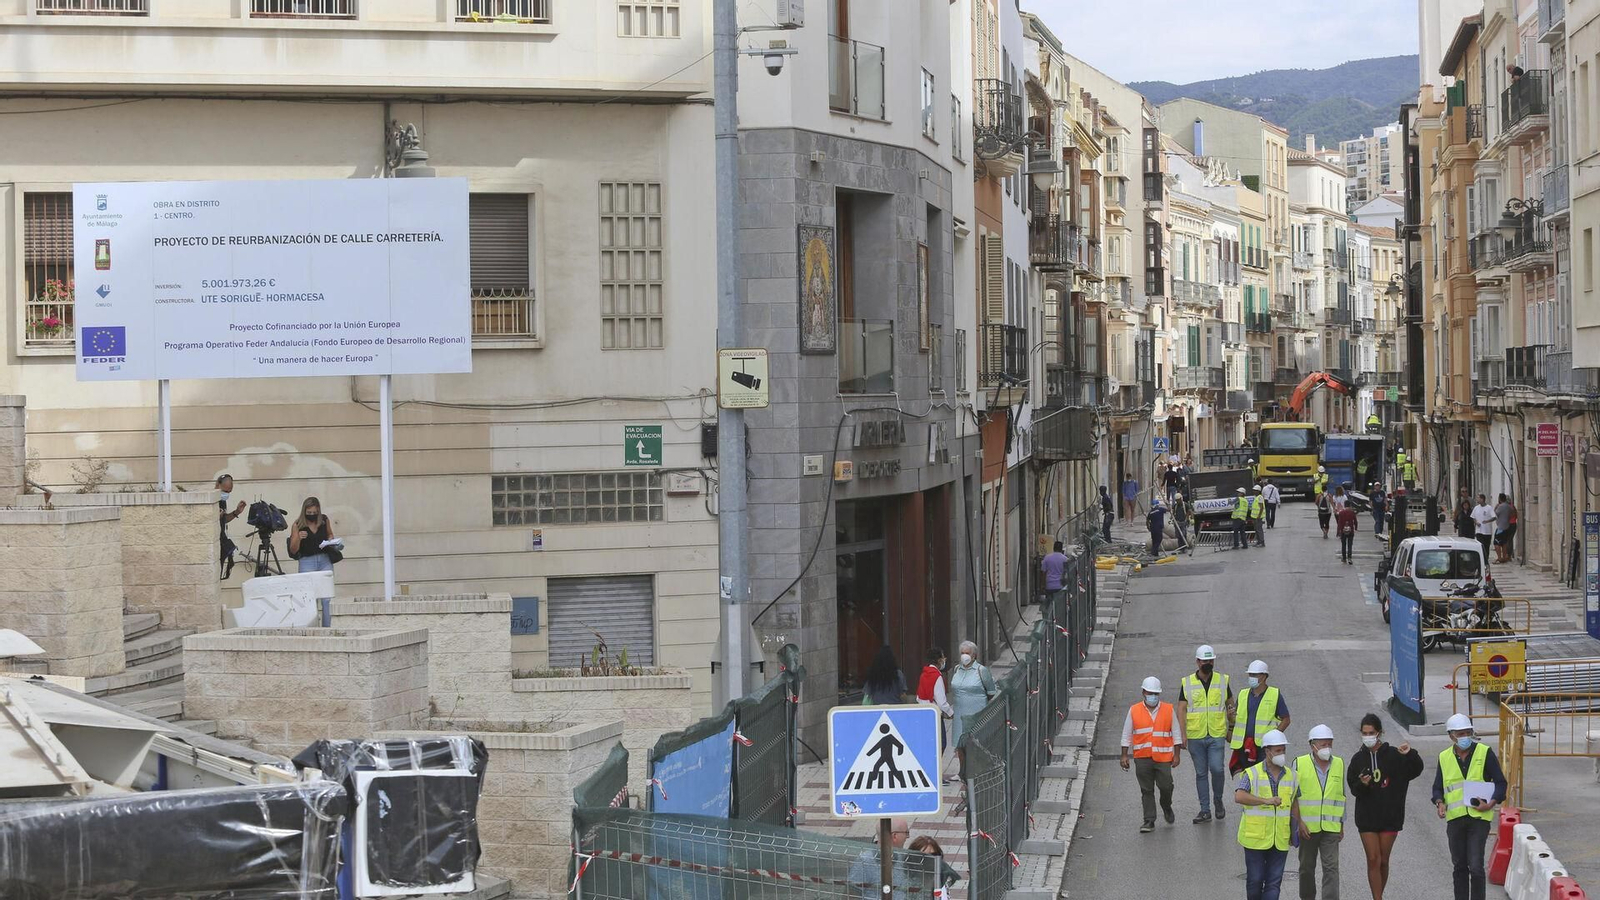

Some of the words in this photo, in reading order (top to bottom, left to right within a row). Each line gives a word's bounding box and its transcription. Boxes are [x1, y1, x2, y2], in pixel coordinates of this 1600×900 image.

[153, 201, 174, 209] OBRA
[175, 200, 185, 208] EN
[187, 200, 220, 208] DISTRITO
[81, 213, 123, 221] Ayuntamiento
[154, 212, 159, 220] 1
[86, 220, 95, 228] de
[96, 219, 118, 228] Málaga
[154, 236, 209, 247] PROYECTO
[211, 236, 226, 246] DE
[228, 233, 321, 245] REURBANIZACIÓN
[323, 234, 338, 244] DE
[340, 233, 374, 243] CALLE
[376, 231, 444, 243] CARRETERÍA.
[268, 278, 276, 288] €
[201, 294, 218, 304] UTE
[266, 292, 325, 302] HORMACESA
[229, 322, 264, 332] Proyecto
[265, 322, 318, 331] Cofinanciado
[319, 322, 332, 331] por
[334, 321, 342, 329] la
[343, 320, 366, 329] Unión
[368, 320, 401, 330] Europea
[164, 341, 204, 351] Programa
[205, 340, 244, 350] Operativo
[245, 339, 268, 348] Feder
[270, 338, 309, 348] Andalucía
[310, 338, 339, 347] (Fondo
[340, 338, 373, 348] Europeo
[374, 336, 385, 345] de
[386, 336, 427, 346] Desarrollo
[428, 335, 466, 345] Regional)
[258, 356, 275, 364] Una
[276, 356, 307, 364] manera
[309, 355, 319, 364] de
[321, 354, 343, 363] hacer
[345, 354, 373, 364] Europa
[1586, 514, 1598, 524] BUS
